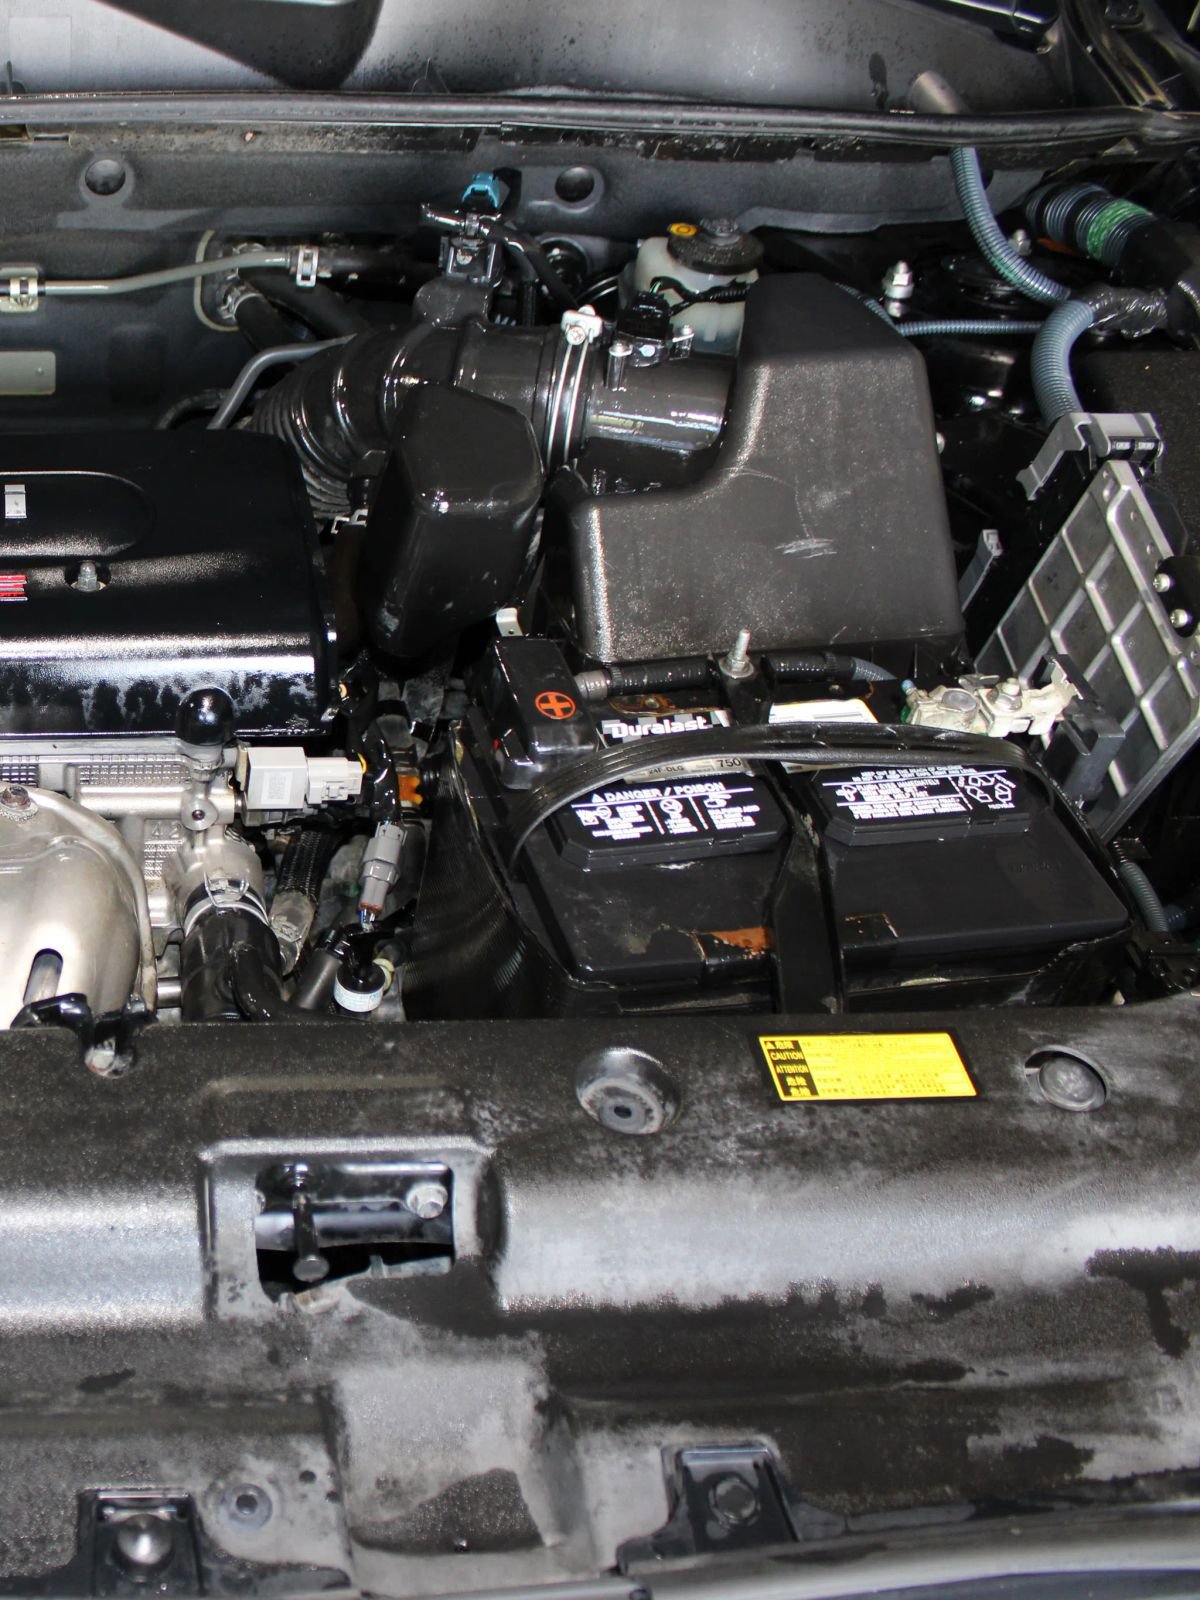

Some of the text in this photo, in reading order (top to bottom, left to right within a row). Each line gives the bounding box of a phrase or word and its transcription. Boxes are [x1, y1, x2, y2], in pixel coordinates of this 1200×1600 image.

[604, 716, 710, 738] Duralast
[717, 758, 742, 768] 750
[603, 787, 662, 802] DANGER
[675, 782, 727, 795] POISON
[770, 1051, 805, 1061] CAUTION
[775, 1064, 810, 1074] ATTENTION
